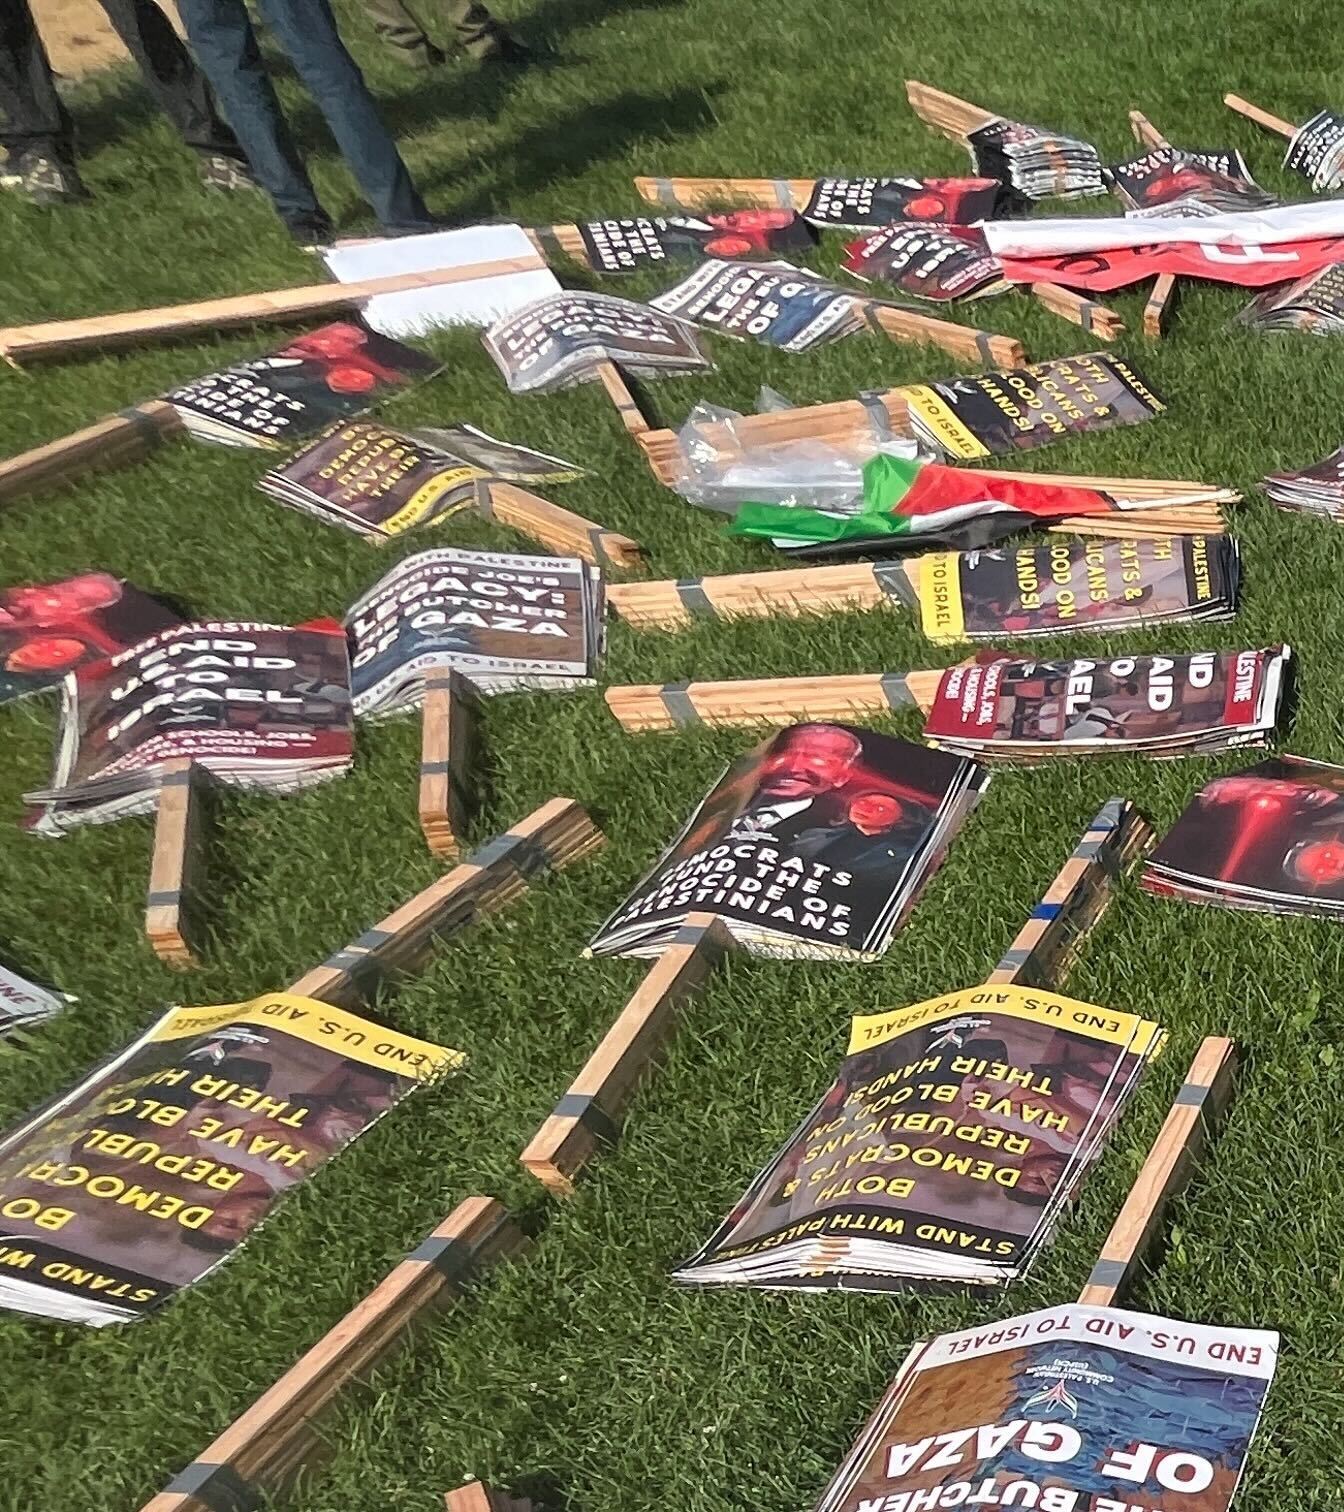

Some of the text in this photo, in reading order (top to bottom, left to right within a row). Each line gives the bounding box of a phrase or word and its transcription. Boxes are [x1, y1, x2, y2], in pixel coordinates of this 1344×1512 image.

[1040, 412, 1067, 434] ON
[410, 610, 571, 638] GAZA
[1055, 591, 1076, 619] ON
[1148, 656, 1175, 712] AID
[756, 862, 822, 895] THE
[802, 897, 852, 918] OF
[952, 1054, 1053, 1097] THEIR
[189, 1072, 310, 1128] THEIR
[967, 1092, 1069, 1134] HAVE
[188, 1116, 307, 1168] HAVE
[915, 1222, 1016, 1257] STAND
[948, 1315, 1262, 1365] END U.S. AID TO ISRAEL
[886, 1419, 1214, 1493] OF GAZA
